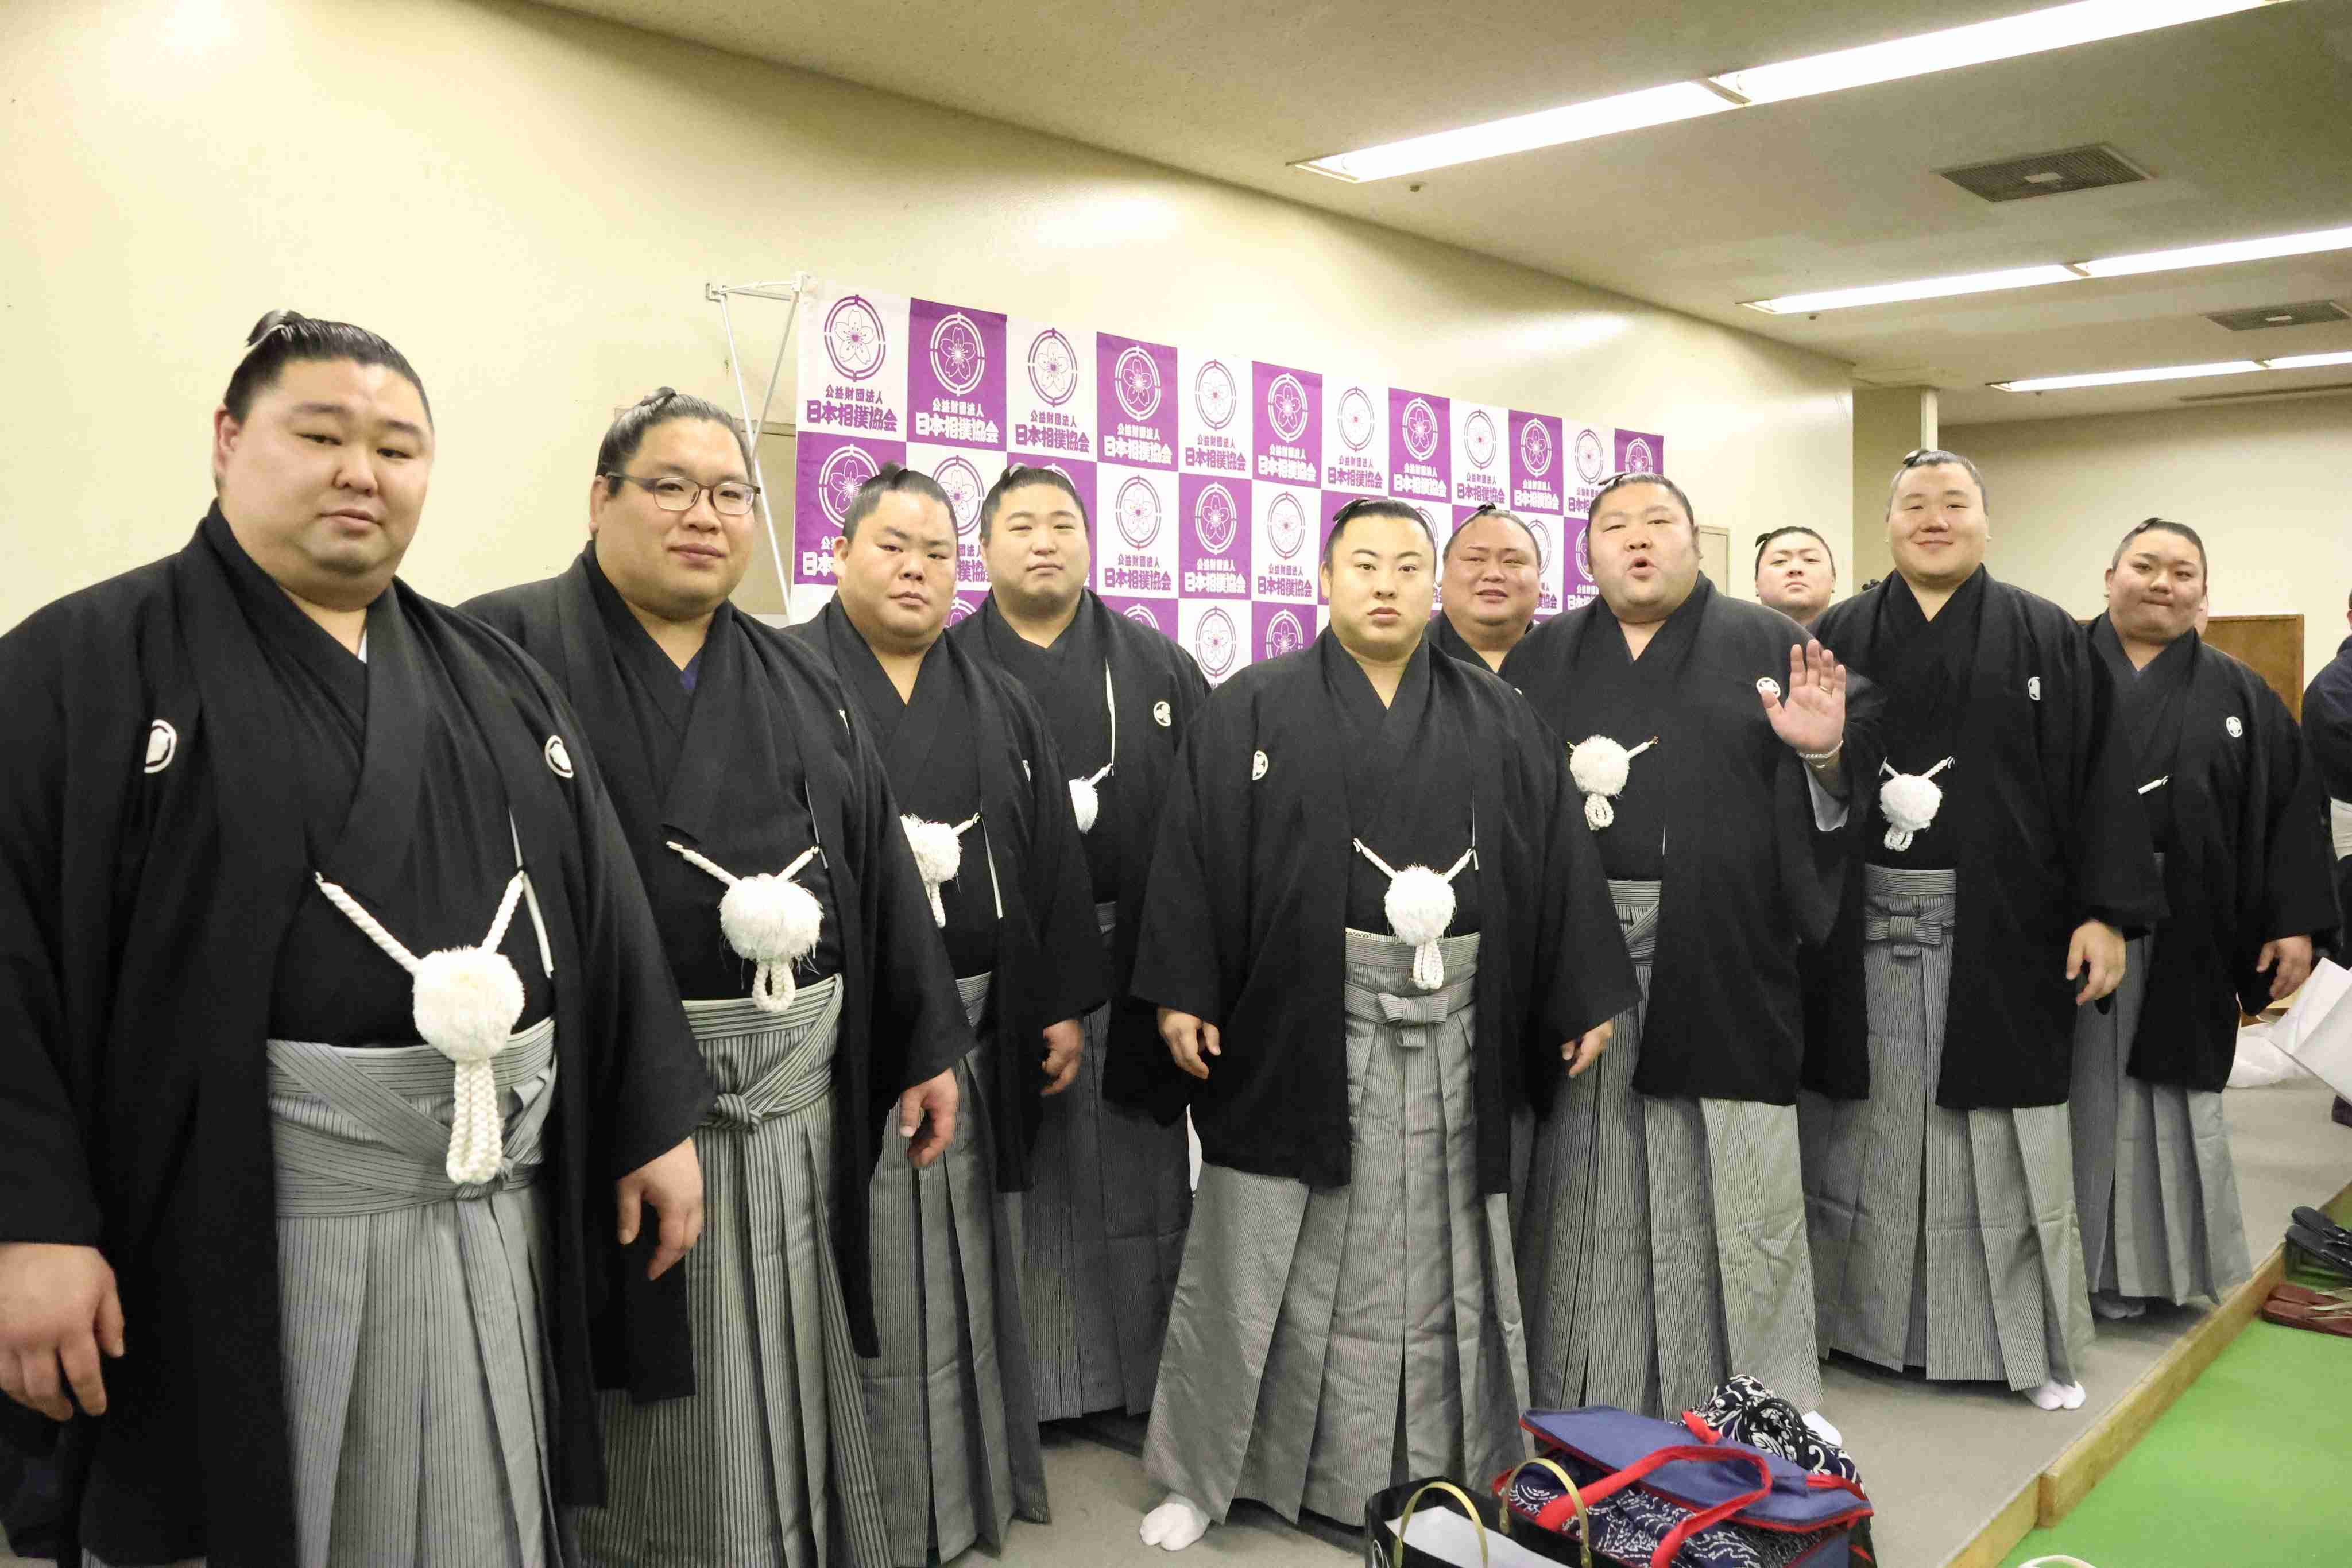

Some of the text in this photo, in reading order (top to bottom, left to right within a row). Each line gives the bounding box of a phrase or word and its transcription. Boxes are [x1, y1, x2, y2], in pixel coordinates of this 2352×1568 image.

[826, 384, 883, 404] 公益財団法人
[807, 400, 898, 432] 日本相撲協会
[916, 411, 999, 444] 日本相撲協会
[1015, 424, 1089, 454] 日本相撲協会
[1104, 435, 1173, 465] 日本相撲協会
[1185, 447, 1246, 471] 日本相撲協会
[1328, 466, 1383, 489] 日本相撲協会
[1104, 567, 1172, 591] 日本相撲協会
[1258, 575, 1312, 598] 日本相撲協会
